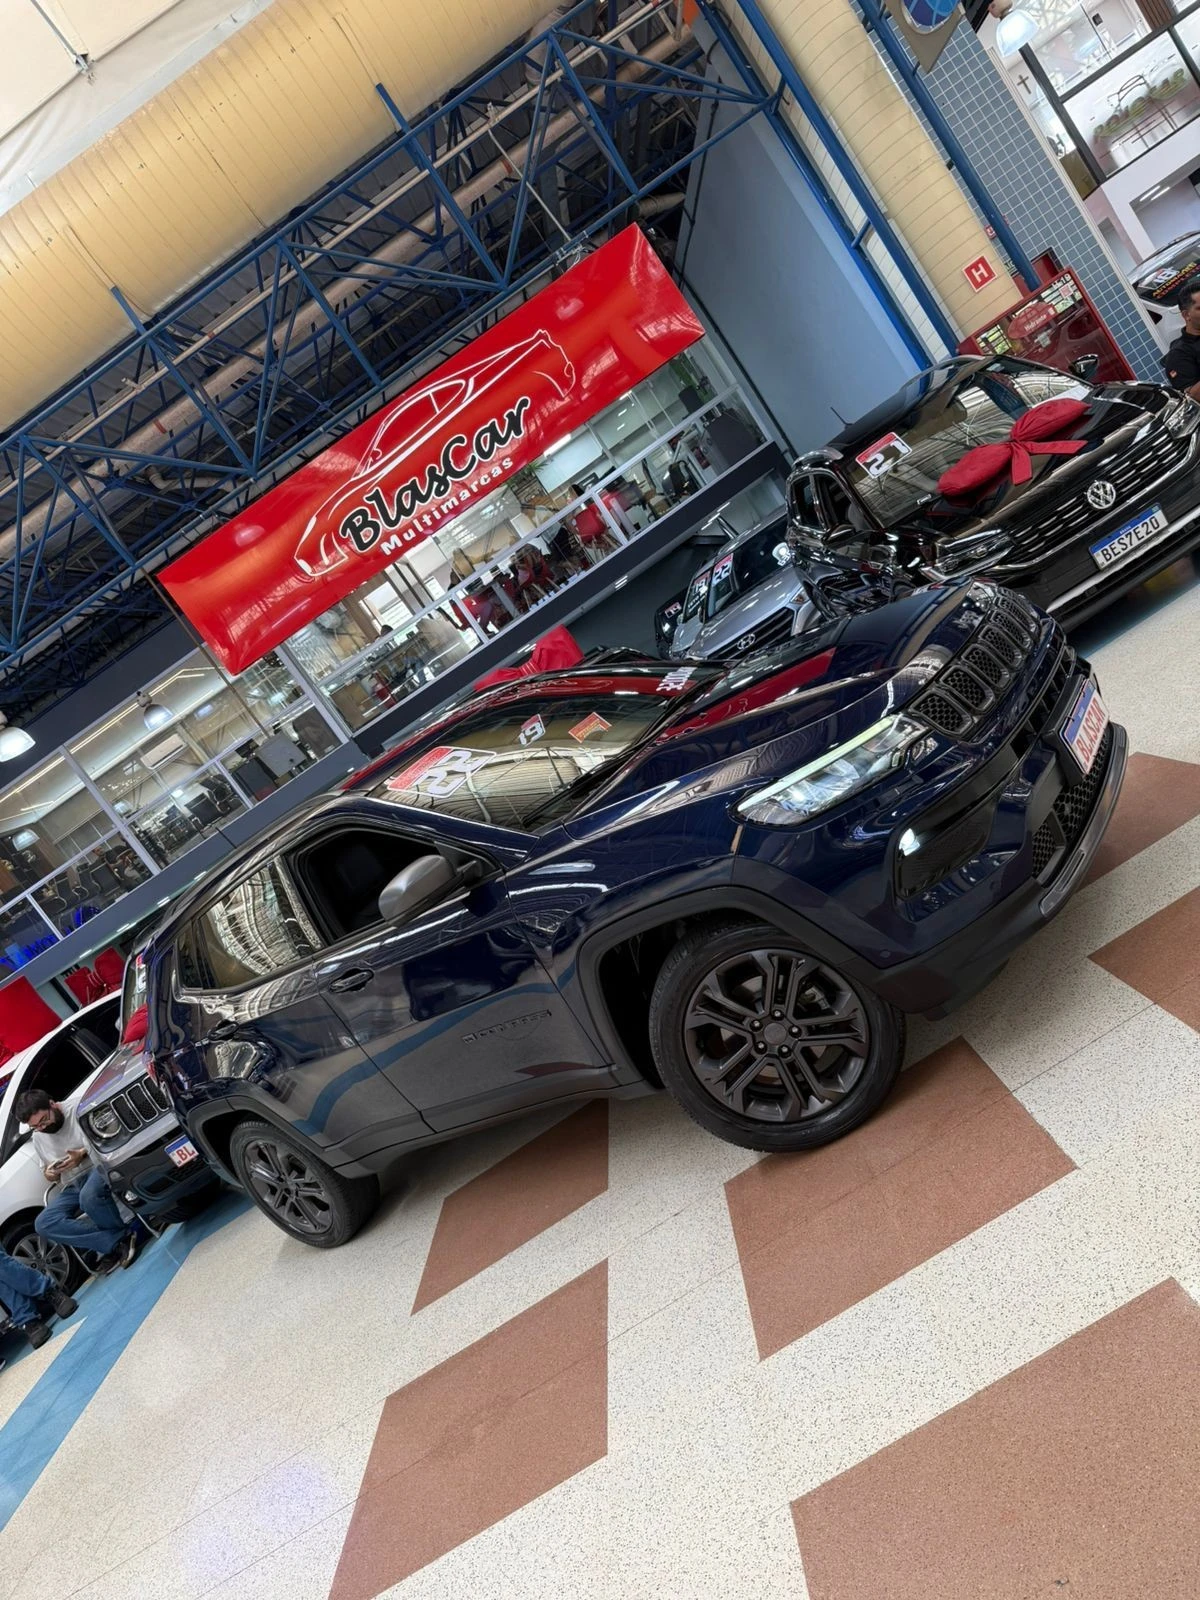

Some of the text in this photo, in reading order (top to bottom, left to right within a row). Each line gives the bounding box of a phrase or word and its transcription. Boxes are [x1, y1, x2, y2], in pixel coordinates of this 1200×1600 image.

[971, 263, 989, 283] H
[340, 396, 530, 551] BlasCar
[865, 440, 909, 475] 21
[380, 456, 513, 556] Multimarcas
[1100, 515, 1160, 562] BES7E20
[1076, 697, 1105, 764] BLASCAR
